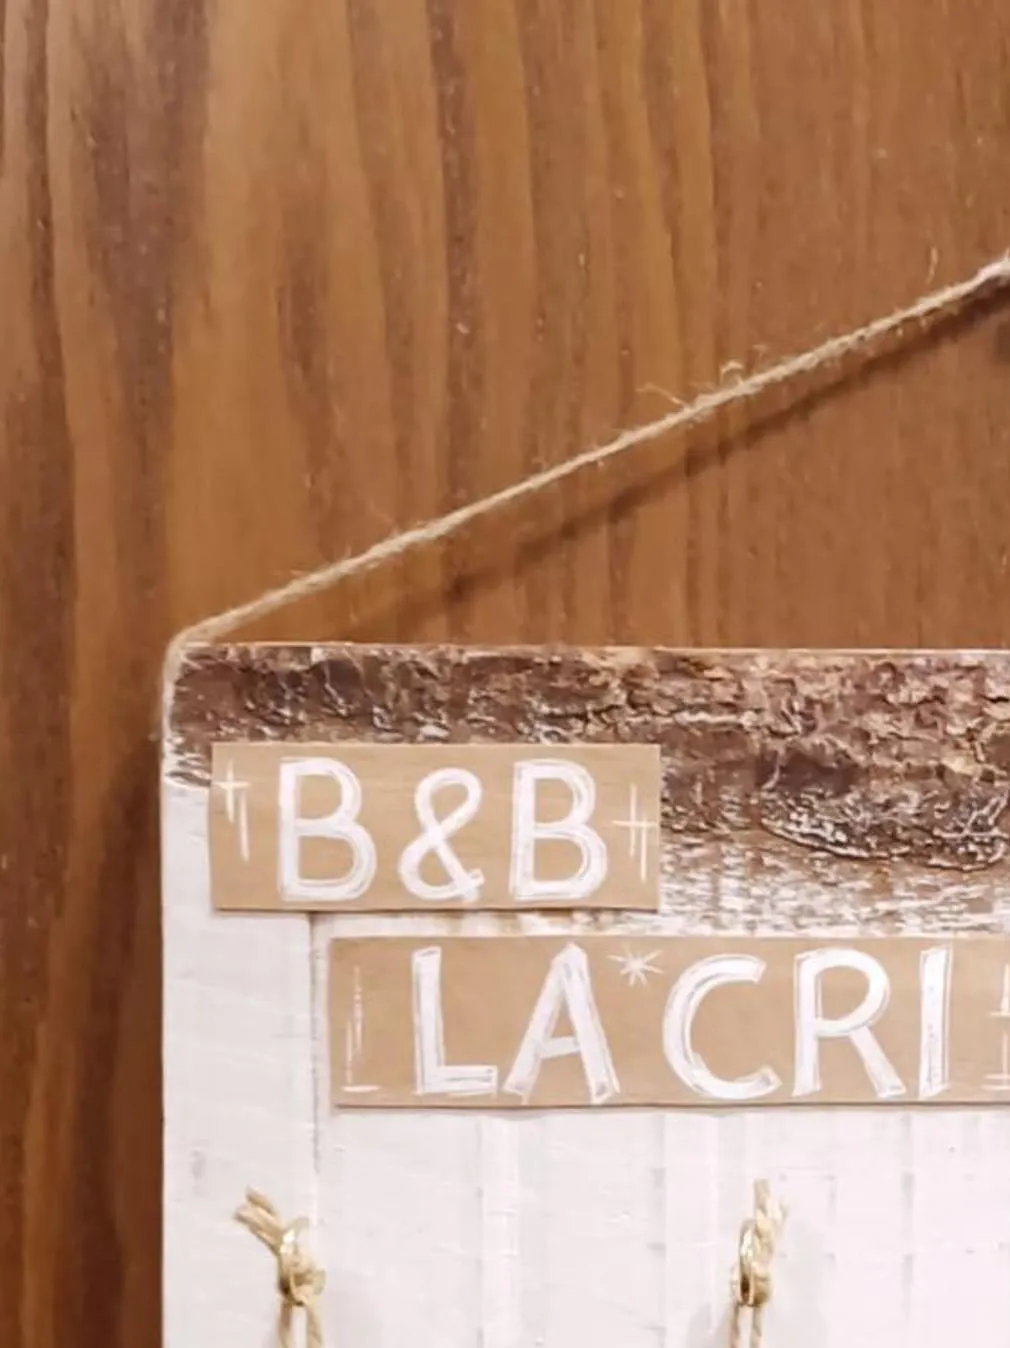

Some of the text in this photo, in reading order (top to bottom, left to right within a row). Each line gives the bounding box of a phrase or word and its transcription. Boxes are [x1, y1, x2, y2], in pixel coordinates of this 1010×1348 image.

[277, 756, 608, 902] B&B
[410, 942, 954, 1104] LA CRI
